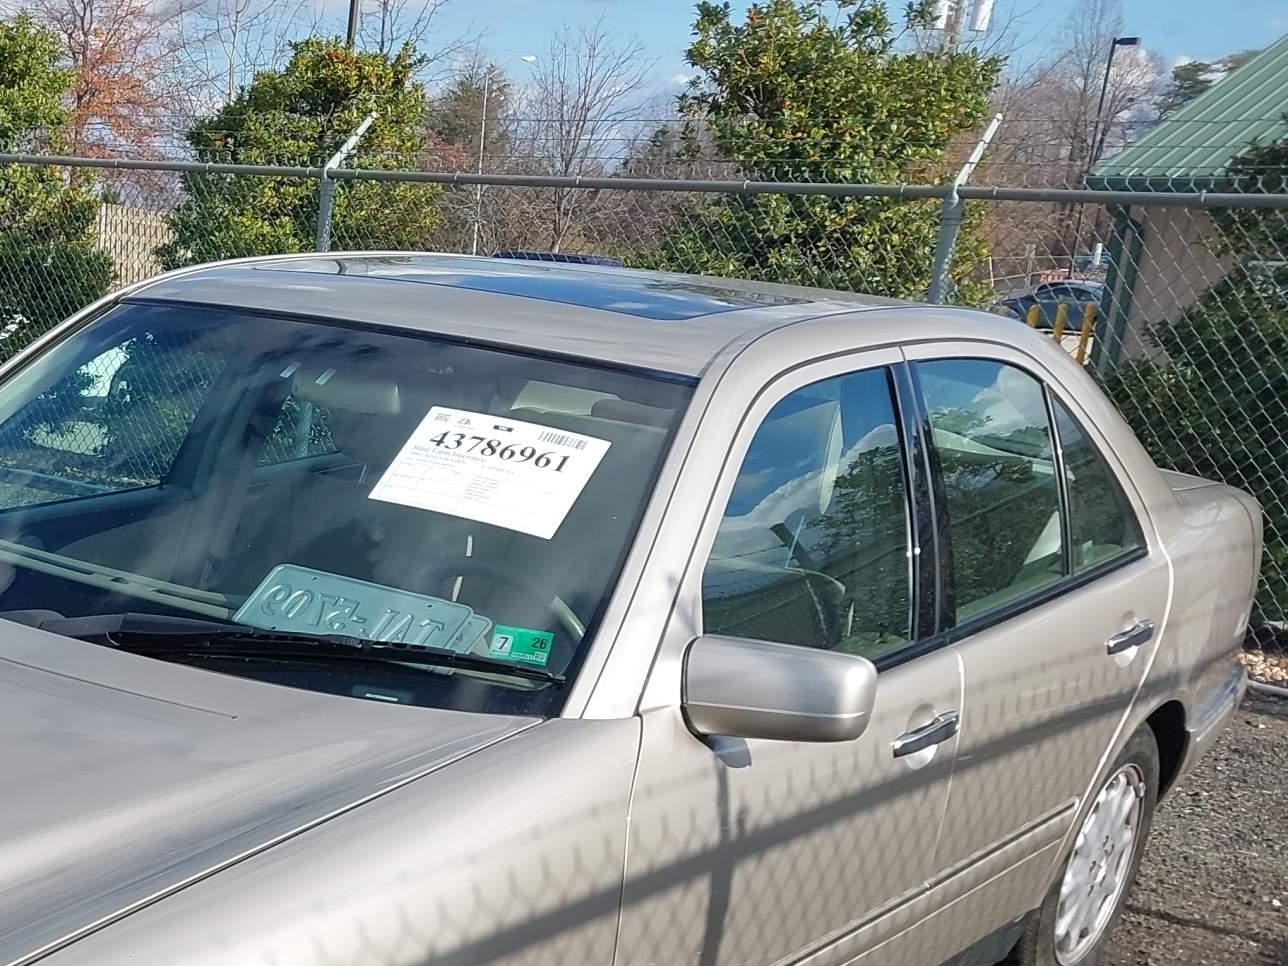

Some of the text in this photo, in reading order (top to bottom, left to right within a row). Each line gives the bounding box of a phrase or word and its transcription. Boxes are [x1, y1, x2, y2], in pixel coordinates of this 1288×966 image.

[428, 430, 571, 473] 43786961
[498, 636, 548, 650] 7 26
